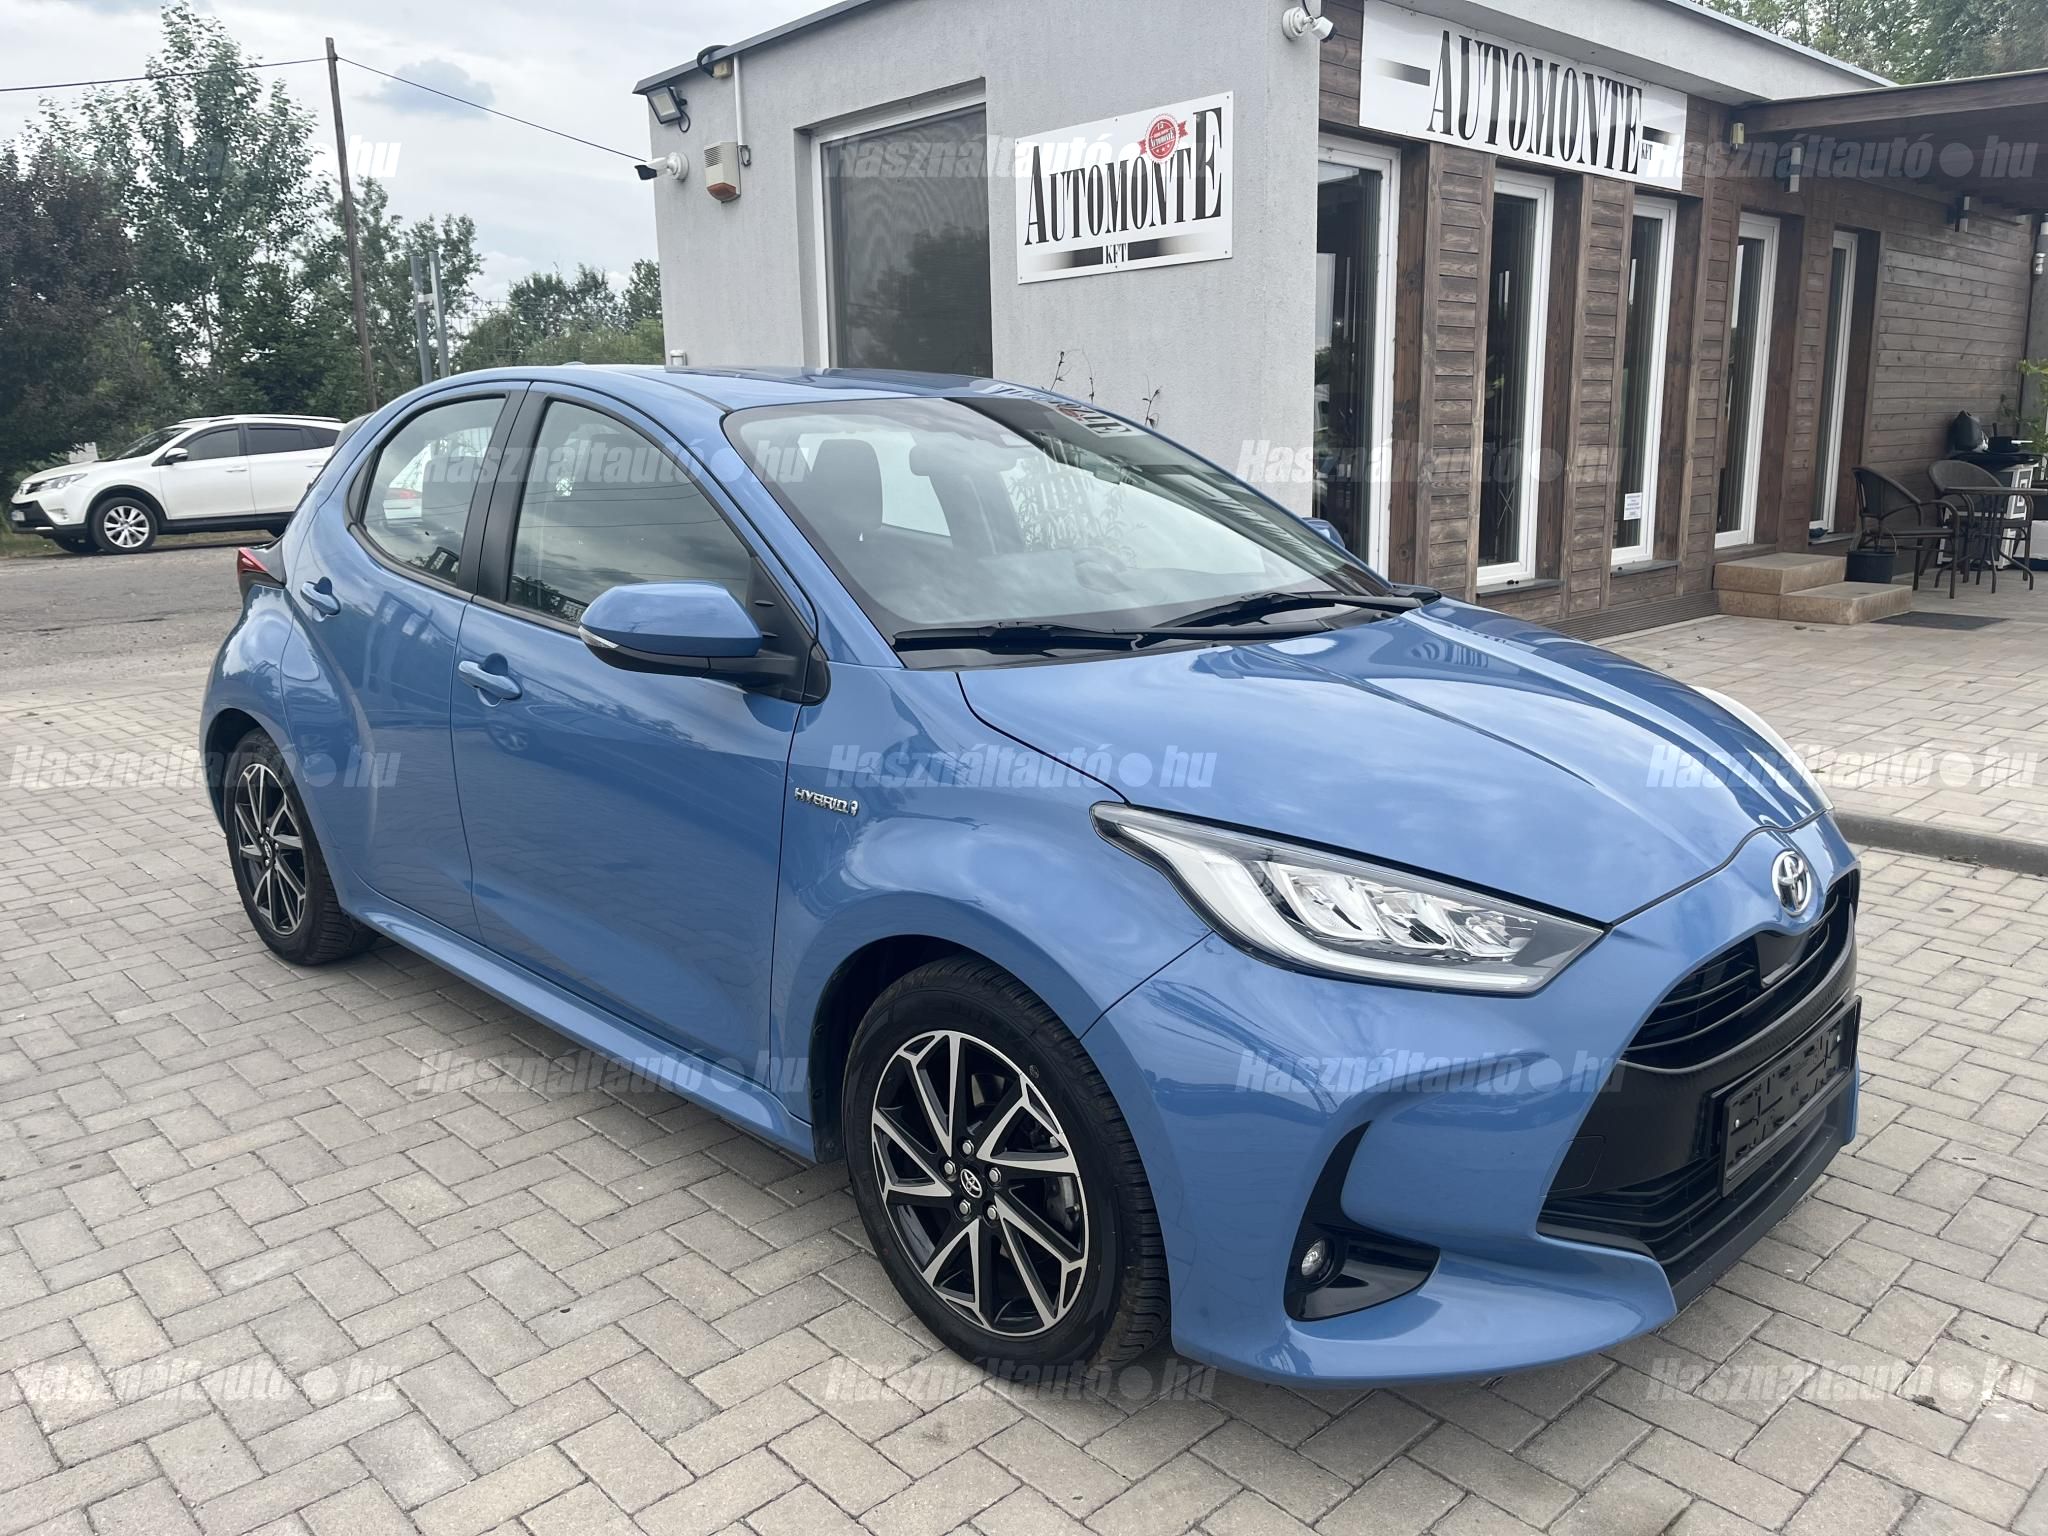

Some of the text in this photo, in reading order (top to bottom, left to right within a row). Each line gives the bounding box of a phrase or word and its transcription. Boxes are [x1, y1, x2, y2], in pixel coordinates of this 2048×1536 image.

[1426, 30, 1643, 175] AUTOMONTE
[1024, 106, 1222, 246] AUTOMONTE
[1105, 243, 1127, 264] KFT
[795, 787, 849, 813] HYBRID
